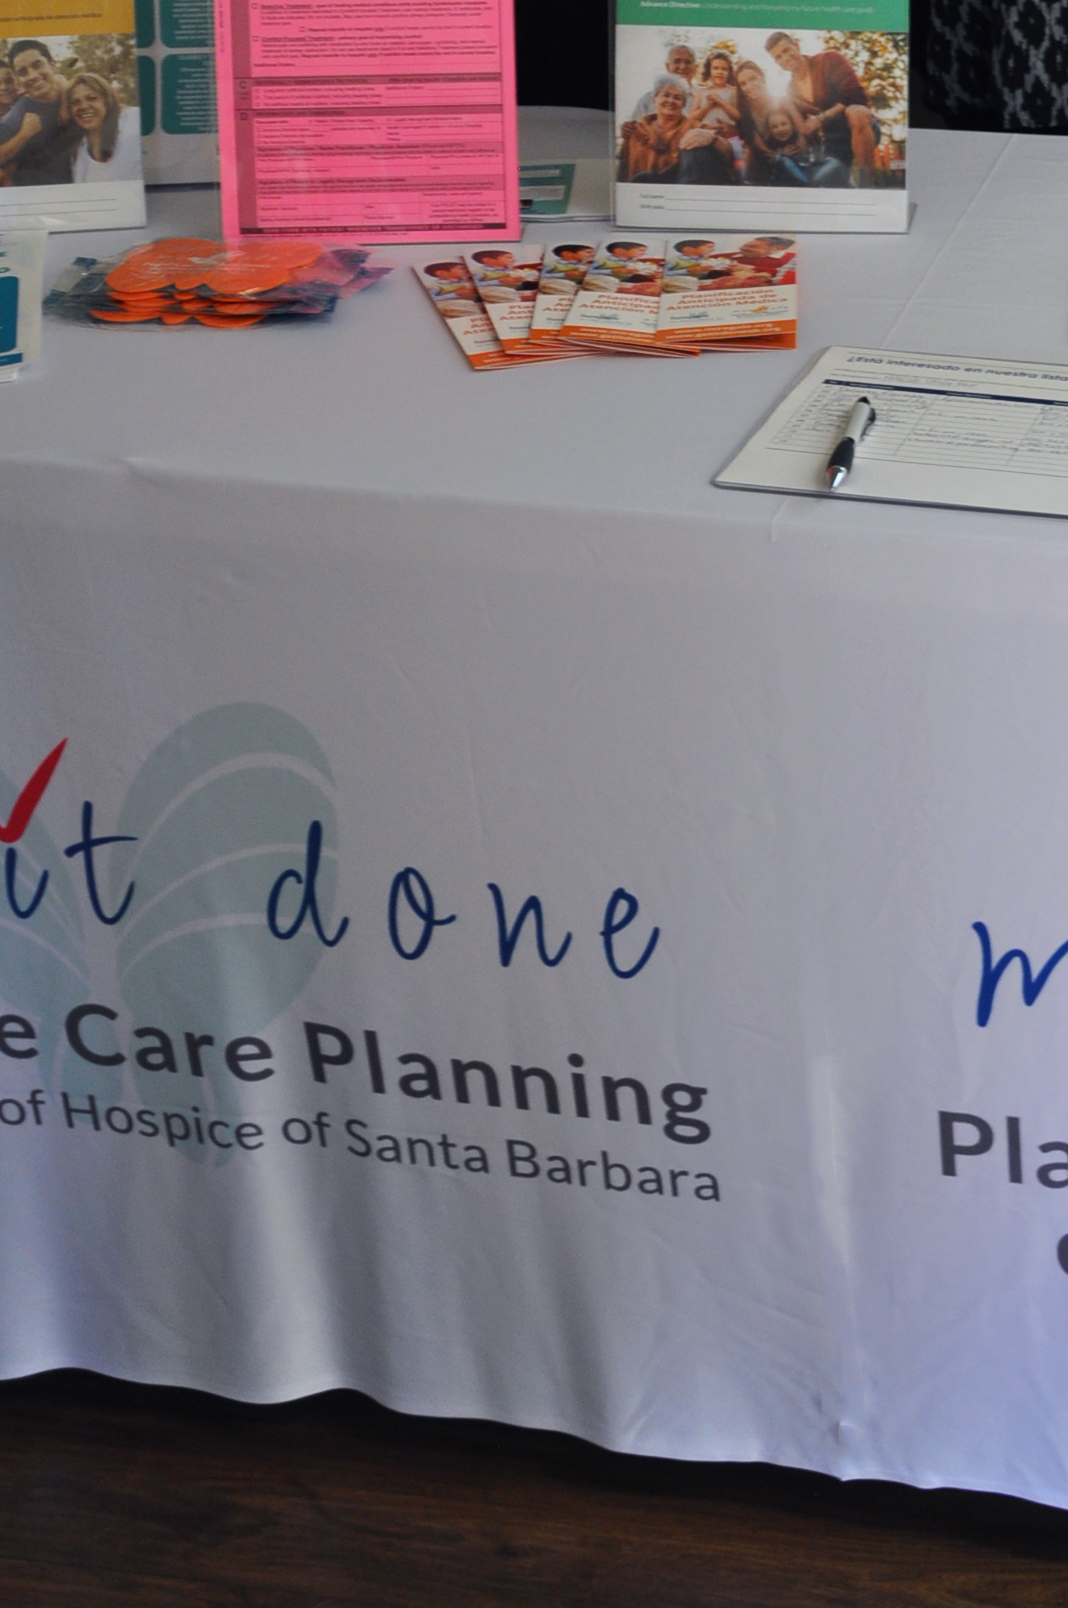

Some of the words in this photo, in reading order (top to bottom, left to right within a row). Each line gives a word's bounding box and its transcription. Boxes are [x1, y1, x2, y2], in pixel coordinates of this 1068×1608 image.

[667, 302, 731, 311] Atención
[735, 297, 787, 306] Médica
[677, 296, 755, 304] Anticipada
[681, 289, 774, 299] Planificación
[846, 355, 883, 365] ¿Está
[886, 358, 961, 372] interesado
[985, 368, 1038, 380] nuestra
[266, 820, 660, 980] done
[64, 1002, 276, 1082] Care
[303, 1020, 712, 1146] Planning
[62, 1091, 265, 1152] Hospice
[281, 1112, 332, 1148] of
[345, 1119, 491, 1177] Santa
[505, 1138, 722, 1203] Barbara
